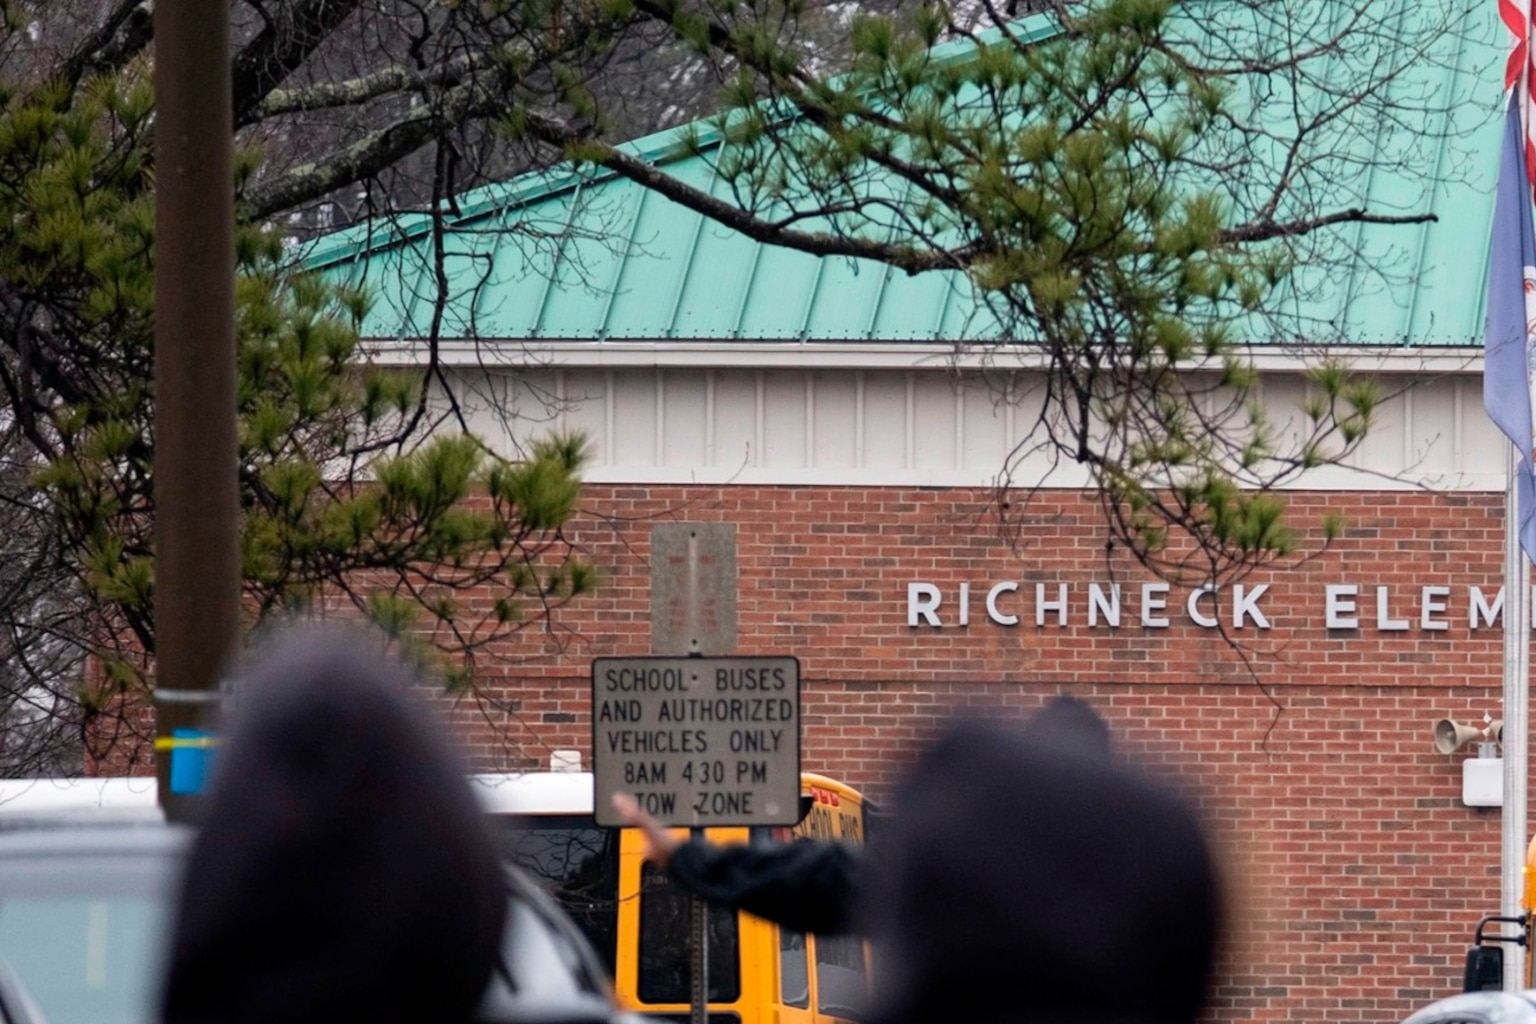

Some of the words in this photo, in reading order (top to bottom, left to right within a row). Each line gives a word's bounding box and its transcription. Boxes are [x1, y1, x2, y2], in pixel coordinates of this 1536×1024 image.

[906, 581, 1271, 628] RICHNECK
[605, 668, 689, 692] SCHOOL
[715, 668, 786, 691] BUSES
[600, 699, 642, 722] AND
[658, 699, 793, 722] AUTHORIZED
[607, 730, 708, 753] VEHICLES
[729, 730, 783, 752] ONLY
[624, 762, 667, 784] 8AM
[737, 761, 767, 783] PM
[697, 792, 754, 815] ZONE
